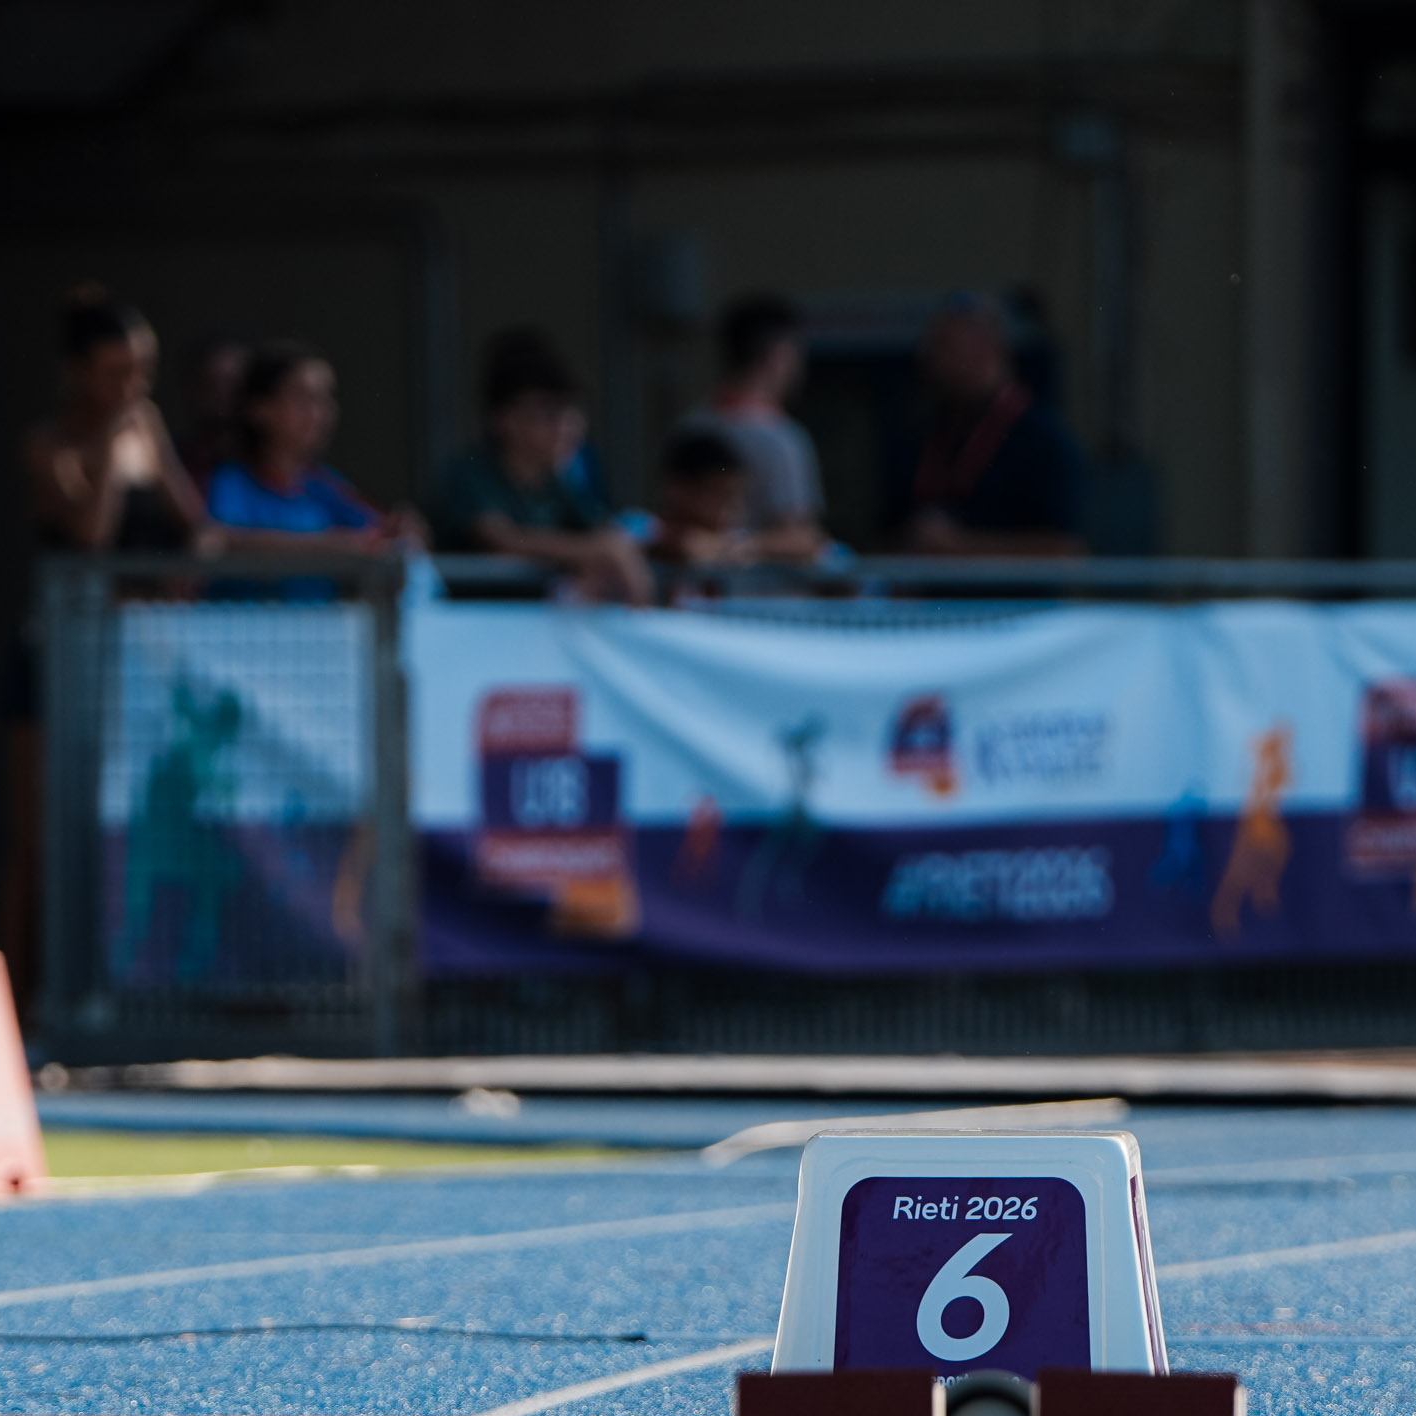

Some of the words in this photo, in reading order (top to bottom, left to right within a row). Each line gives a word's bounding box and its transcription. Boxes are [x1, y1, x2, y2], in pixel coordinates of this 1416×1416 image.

[892, 1195, 959, 1220] Rieti
[965, 1196, 1039, 1221] 2026
[916, 1233, 1014, 1362] 6
